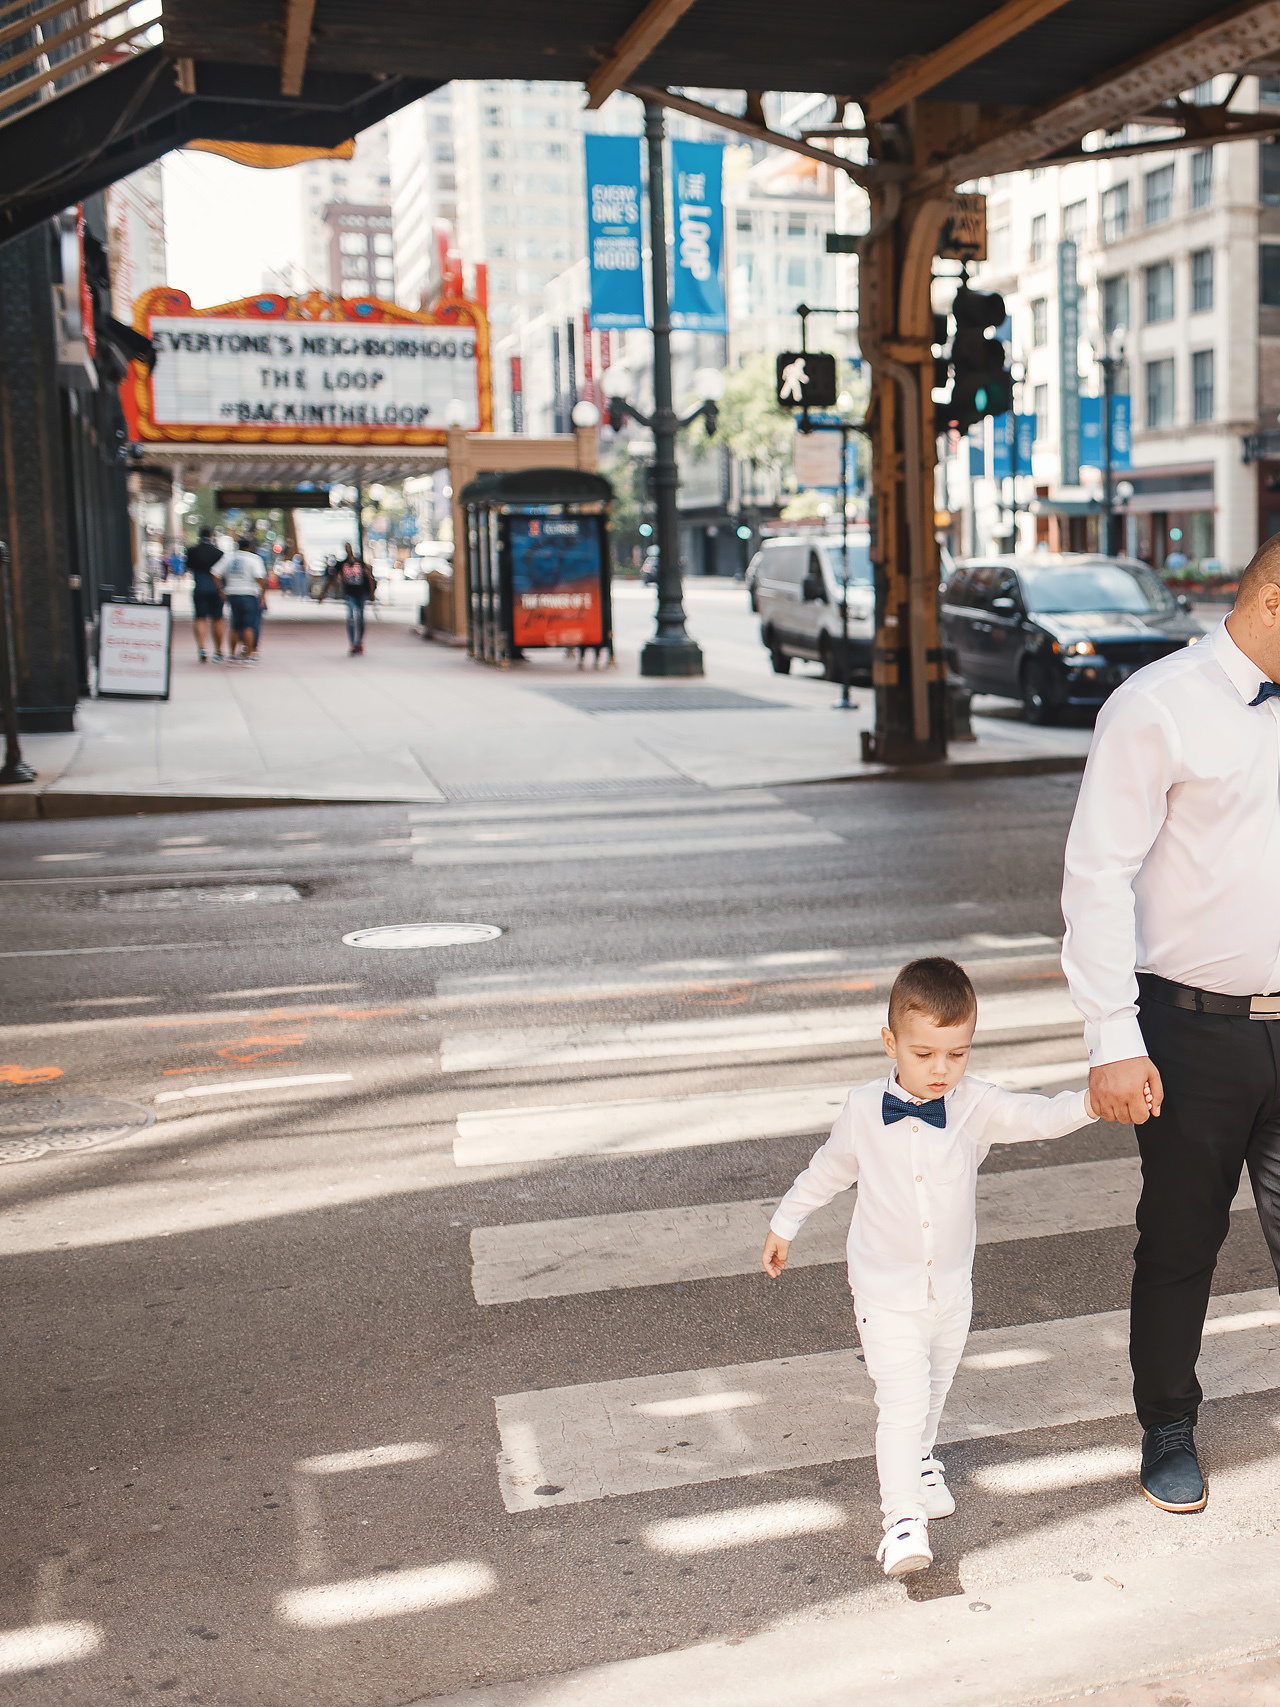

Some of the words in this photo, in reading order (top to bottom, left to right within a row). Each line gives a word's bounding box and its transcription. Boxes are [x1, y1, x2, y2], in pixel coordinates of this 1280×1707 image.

[592, 184, 638, 202] EVERY
[592, 201, 639, 224] ONE'S
[679, 203, 712, 281] LOOP
[152, 331, 293, 354] EVERYONE'S
[301, 336, 475, 359] NEIGHBORHOOD
[260, 367, 307, 391] THE
[323, 371, 384, 392] LOOP
[219, 402, 430, 425] #BACKINTHELOOP
